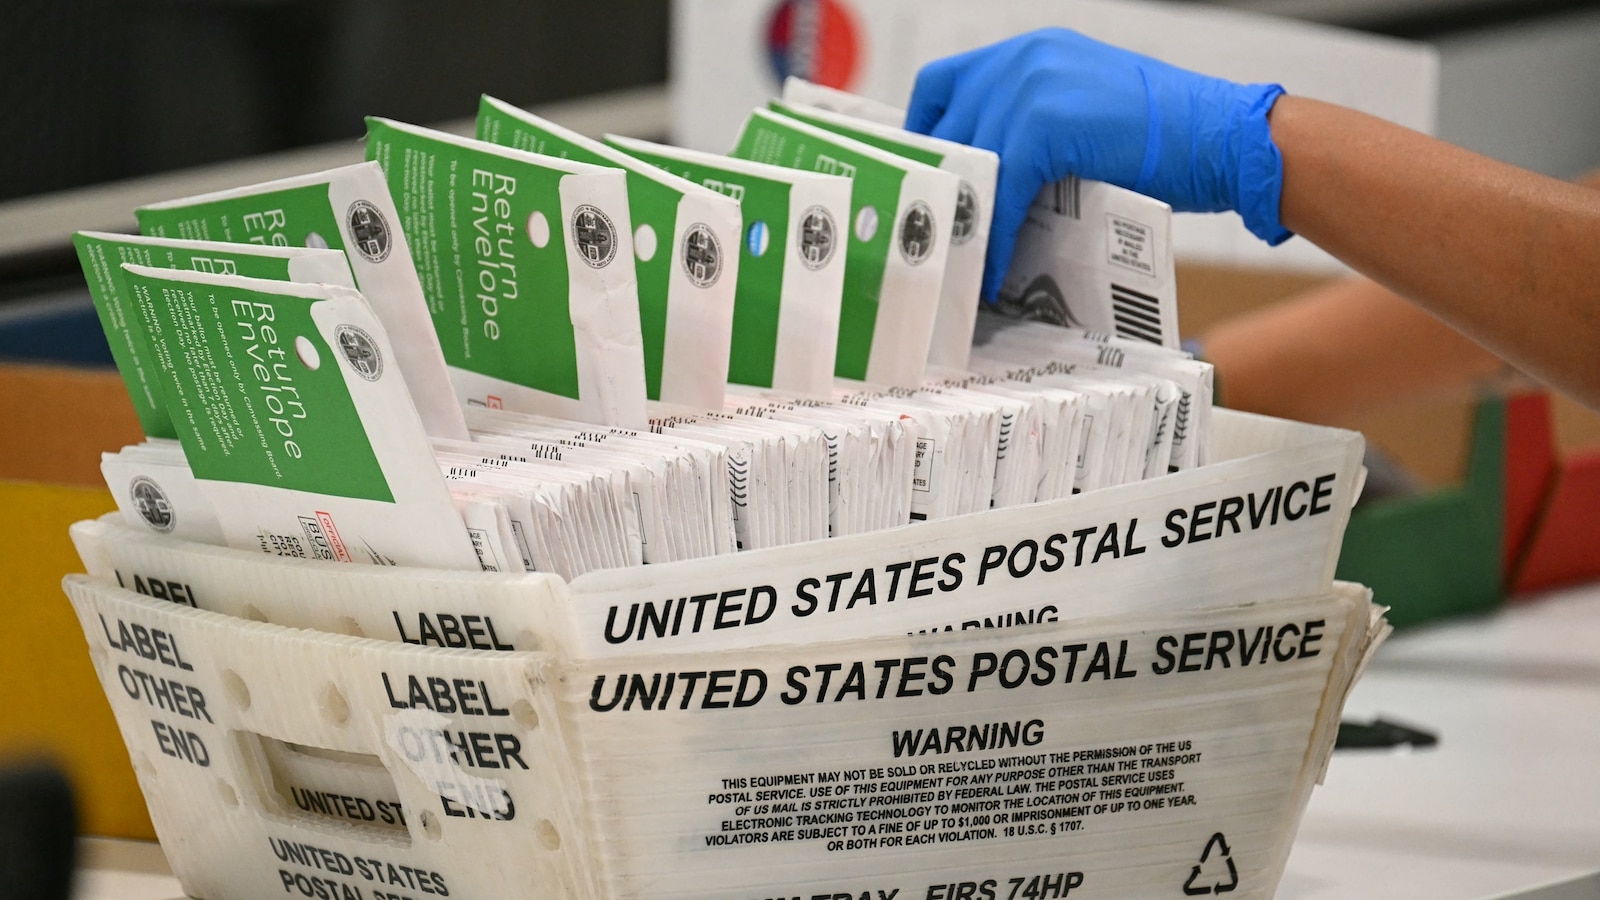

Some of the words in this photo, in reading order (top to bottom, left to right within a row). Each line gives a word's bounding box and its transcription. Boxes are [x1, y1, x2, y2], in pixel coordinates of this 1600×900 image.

[472, 168, 500, 340] Envelope
[494, 174, 518, 300] Return
[134, 284, 150, 323] election
[148, 325, 154, 333] is
[154, 344, 167, 372] crime.
[142, 286, 162, 336] WARNING:
[160, 338, 174, 368] Voting
[171, 371, 184, 396] twice
[181, 398, 188, 407] in
[186, 409, 195, 425] the
[193, 427, 207, 451] same
[162, 288, 179, 326] Election
[176, 329, 186, 348] Day.
[184, 352, 192, 365] No
[188, 367, 208, 405] postage
[205, 407, 211, 415] is
[209, 417, 231, 456] required.
[170, 289, 188, 330] received
[184, 332, 192, 345] no
[189, 347, 201, 368] later
[198, 371, 210, 392] than
[211, 403, 223, 424] days
[221, 427, 234, 448] after
[177, 290, 202, 347] postmarked
[198, 350, 205, 361] by
[202, 363, 221, 401] Election
[218, 403, 229, 421] Day
[226, 423, 239, 440] and
[187, 291, 197, 312] Your
[194, 315, 207, 343] ballot
[204, 346, 216, 369] must
[213, 371, 221, 383] be
[219, 386, 240, 426] returned
[236, 427, 244, 437] or
[208, 294, 215, 304] To
[212, 307, 220, 319] be
[217, 322, 233, 358] opened
[229, 360, 241, 380] only
[238, 383, 246, 394] by
[244, 396, 268, 448] Canvassing
[266, 450, 283, 479] Board.
[231, 300, 302, 458] Envelope
[252, 302, 306, 418] Return
[324, 518, 345, 558] OFFICIAL
[604, 585, 777, 644] UNITED
[792, 553, 965, 617] STATES
[977, 518, 1147, 586] POSTAL
[1161, 473, 1336, 548] SERVICE
[99, 612, 194, 672] LABEL
[392, 610, 515, 651] LABEL
[589, 669, 768, 712] UNITED
[780, 655, 956, 704] STATES
[968, 640, 1138, 692] POSTAL
[1152, 620, 1326, 675] SERVICE
[118, 664, 214, 724] OTHER
[382, 672, 510, 716] LABEL
[151, 719, 210, 768] END
[400, 727, 530, 770] OTHER
[721, 778, 747, 790] THIS
[750, 773, 815, 788] EQUIPMENT
[818, 771, 841, 783] MAY
[844, 769, 866, 782] NOT
[869, 768, 884, 780] BE
[887, 765, 917, 778] SOLD
[919, 764, 936, 775] OR
[998, 754, 1047, 768] WITHOUT
[1049, 752, 1070, 764] THE
[1072, 746, 1137, 762] PERMISSION
[1139, 744, 1153, 755] OF
[1156, 742, 1176, 754] THE
[1178, 740, 1192, 751] US
[892, 719, 1044, 758] WARNING
[291, 787, 375, 822] UNITED
[436, 781, 515, 821] END
[708, 792, 752, 804] POSTAL
[755, 788, 806, 801] SERVICE.
[810, 786, 832, 798] USE
[835, 785, 850, 796] OF
[853, 783, 877, 794] THIS
[880, 777, 944, 792] EQUIPMENT
[946, 775, 969, 787] FOR
[970, 773, 994, 785] ANY
[994, 768, 1046, 783] PURPOSE
[1048, 765, 1084, 778] OTHER
[1087, 762, 1115, 774] THAN
[1118, 760, 1138, 771] THE
[1140, 753, 1202, 768] TRANSPORT
[735, 806, 751, 816] OF
[754, 804, 769, 815] US
[771, 803, 798, 814] MAIL
[801, 801, 812, 811] IS
[814, 797, 867, 810] STRICTLY
[869, 791, 935, 807] PROHIBITED
[938, 790, 953, 801] BY
[955, 786, 1004, 800] FEDERAL
[1007, 783, 1032, 795] LAW.
[1035, 781, 1056, 792] THE
[1058, 777, 1099, 790] POSTAL
[1101, 772, 1146, 786] SERVICE
[1148, 769, 1175, 782] USES
[705, 832, 769, 846] VIOLATORS
[771, 830, 794, 842] ARE
[797, 826, 849, 840] SUBJECT
[851, 825, 866, 836] TO
[868, 824, 876, 835] A
[878, 822, 903, 834] FINE
[906, 820, 921, 832] OF
[924, 819, 939, 830] UP
[941, 818, 956, 829] TO
[958, 814, 990, 828] $1,000
[993, 813, 1009, 824] OR
[1011, 805, 1091, 822] IMPRISONMENT
[1093, 804, 1108, 815] OF
[1110, 802, 1125, 813] UP
[1127, 800, 1141, 811] TO
[1143, 798, 1165, 810] ONE
[722, 816, 793, 831] ELECTRONIC
[796, 812, 854, 826] TRACKING
[856, 806, 932, 821] TECHNOLOGY
[934, 804, 949, 815] TO
[951, 800, 1001, 814] MONITOR
[1003, 798, 1024, 809] THE
[1026, 793, 1080, 807] LOCATION
[1082, 791, 1097, 802] OF
[1099, 789, 1122, 800] THIS
[1124, 782, 1184, 798] EQUIPMENT.
[827, 840, 844, 851] OR
[846, 838, 877, 850] BOTH
[880, 836, 903, 848] FOR
[905, 833, 936, 846] EACH
[938, 828, 997, 843] VIOLATION.
[1003, 826, 1015, 837] 18
[1017, 823, 1048, 836] U.S.C.
[1060, 820, 1084, 832] 1707.
[268, 836, 354, 876] UNITED
[354, 856, 450, 896] STATES
[279, 869, 365, 900] POSTAL
[1008, 872, 1084, 900] 74HP
